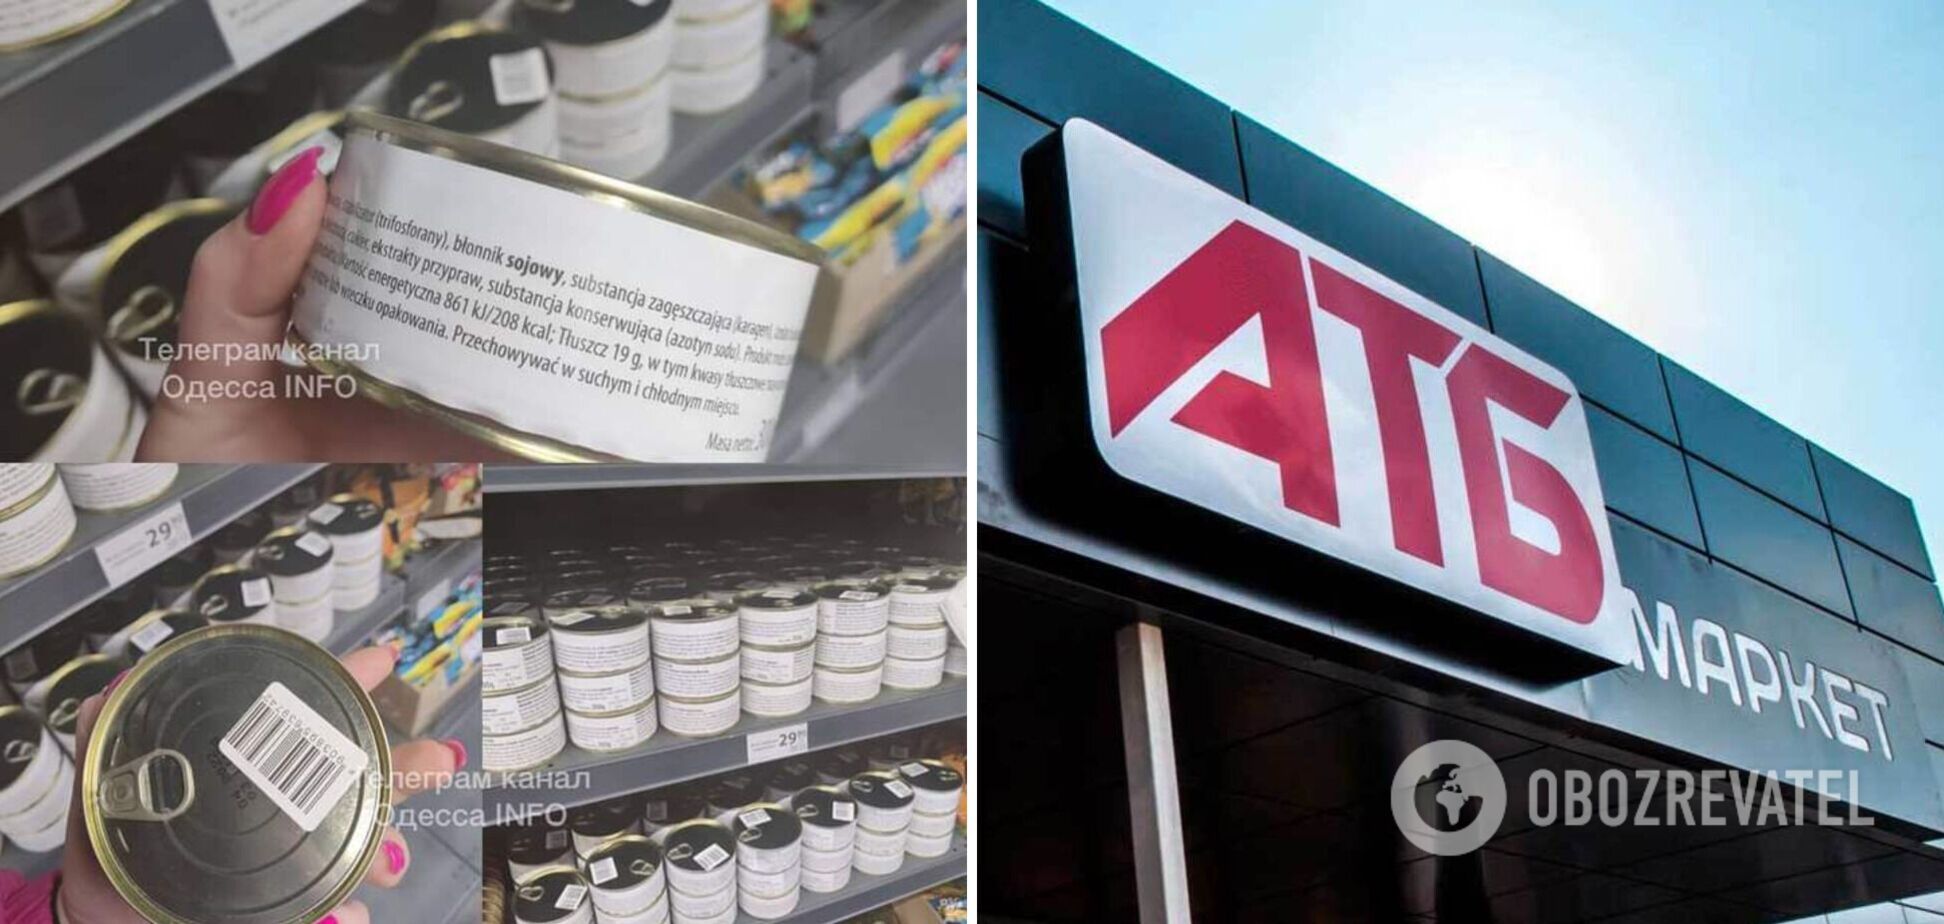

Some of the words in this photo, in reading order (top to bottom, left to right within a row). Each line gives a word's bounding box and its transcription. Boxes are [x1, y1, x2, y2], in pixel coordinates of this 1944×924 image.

[367, 267, 442, 305] energetyczna
[443, 292, 469, 315] 861
[472, 300, 520, 331] kJ/208
[521, 315, 556, 345] kcal;
[558, 325, 608, 358] Tłuszcz
[613, 343, 630, 363] 19
[648, 356, 661, 371] w
[663, 357, 688, 379] tym
[690, 363, 723, 389] kwasy
[371, 238, 420, 271] ekstrakty
[421, 257, 484, 292] przypraw,
[487, 278, 563, 315] substancja
[566, 298, 662, 343] konserwująca
[665, 327, 713, 357] (azotyn
[375, 209, 450, 250] (trifosforany),
[453, 233, 504, 266] błonnik
[505, 253, 567, 287] sojowy,
[570, 273, 646, 309] substancja
[648, 296, 732, 333] zagęszczająca
[375, 299, 448, 340] opakowania.
[452, 324, 561, 374] Przechowywać
[562, 364, 576, 378] w
[577, 367, 632, 394] suchym
[634, 380, 640, 396] i
[642, 382, 702, 412] chłodnym
[1100, 218, 1605, 625] АТБ
[1623, 586, 1894, 762] МАРКЕТ
